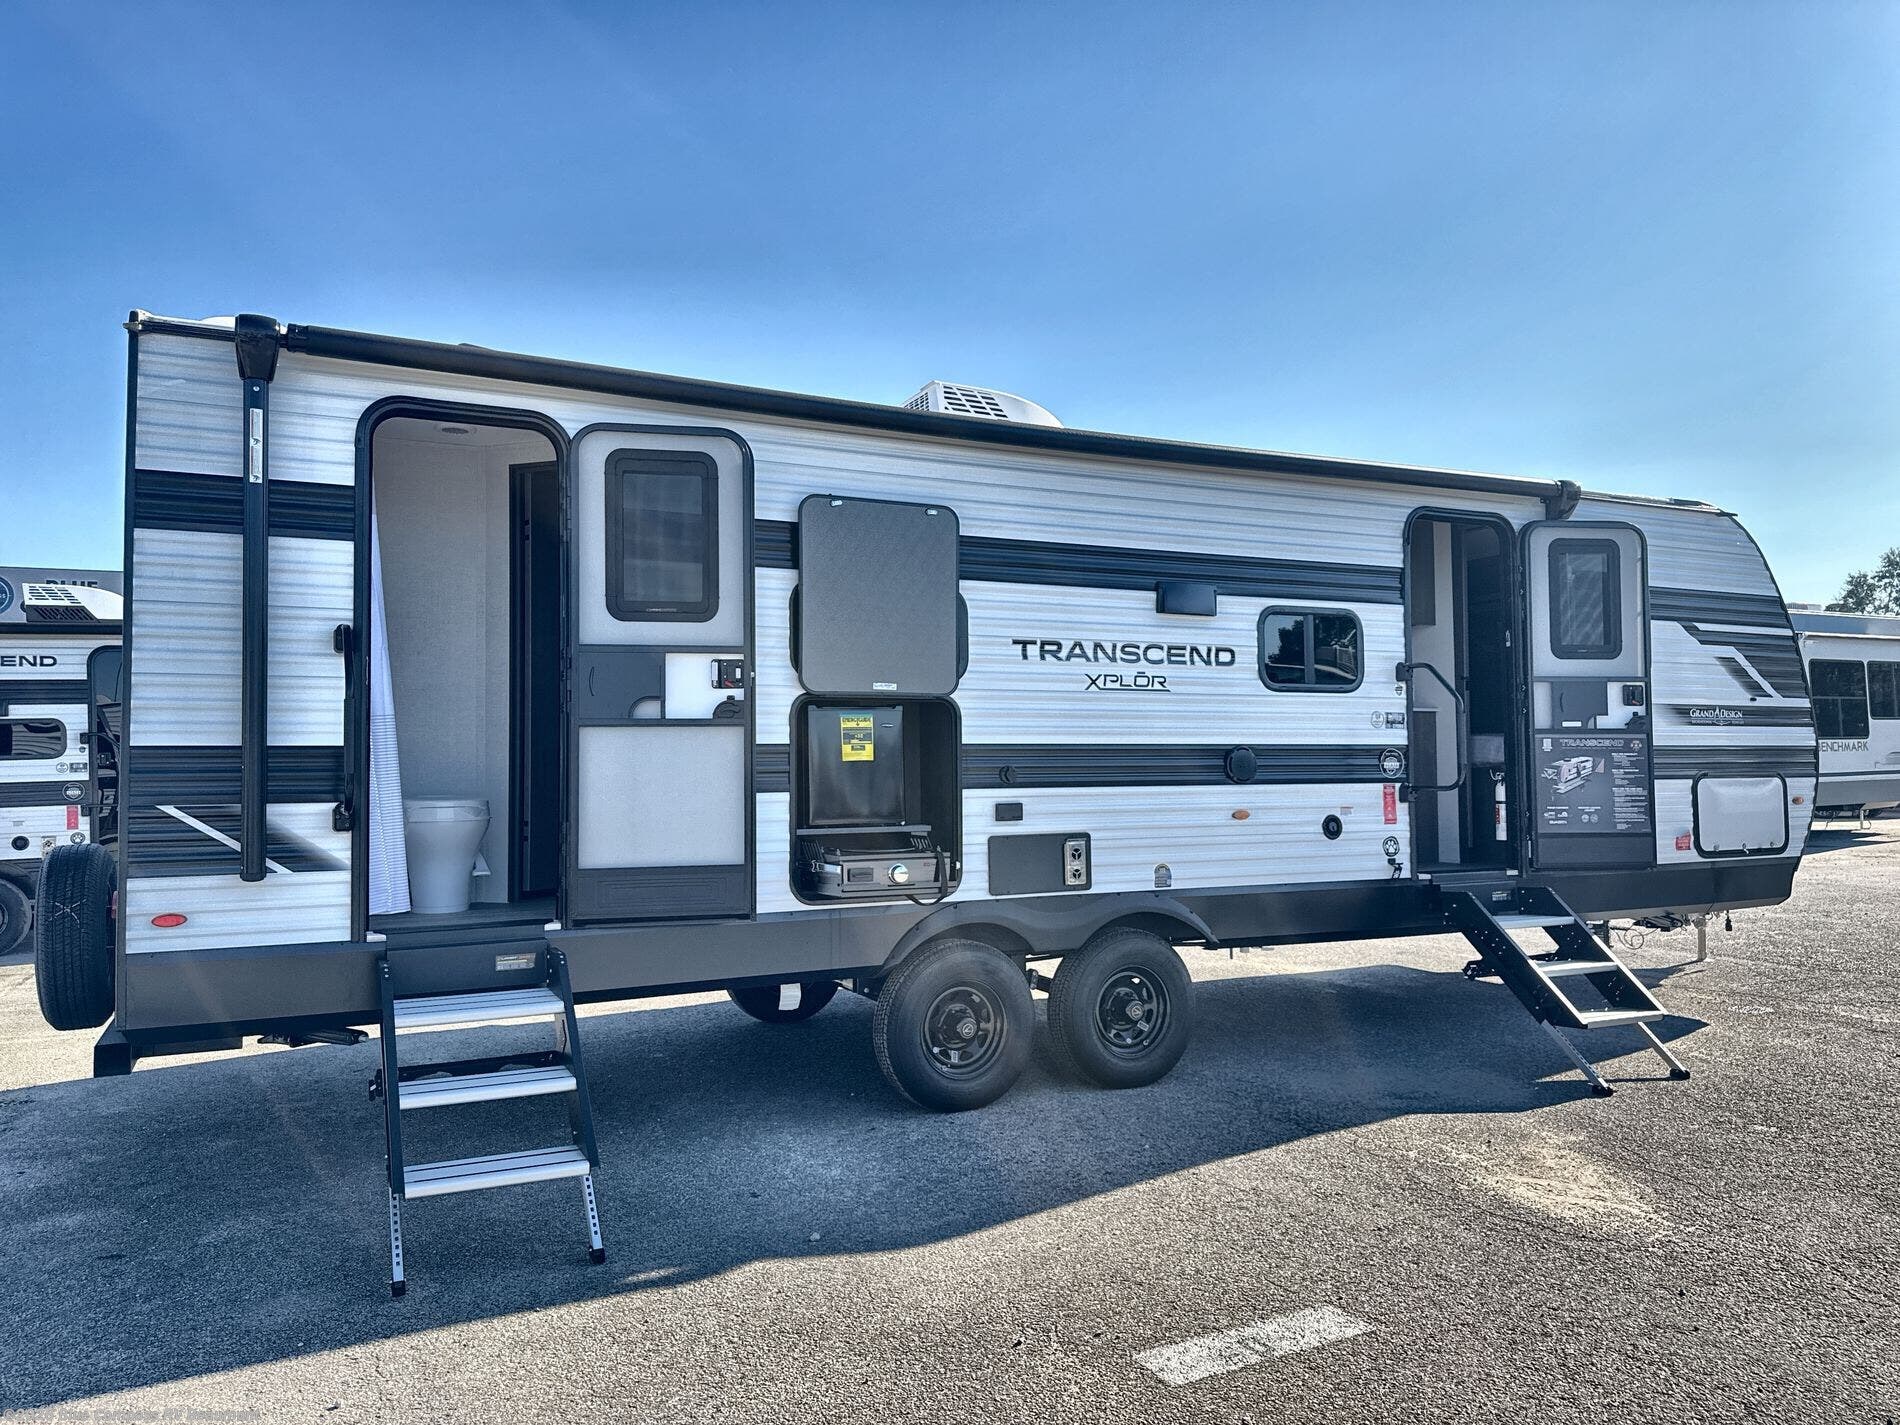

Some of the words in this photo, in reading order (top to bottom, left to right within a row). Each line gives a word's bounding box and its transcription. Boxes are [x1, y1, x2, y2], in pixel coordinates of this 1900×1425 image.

[1012, 638, 1237, 667] TRANSCEND
[0, 655, 58, 667] END
[1690, 708, 1714, 718] GRAND
[1720, 709, 1743, 718] DESIGN
[1559, 738, 1625, 748] TRANSCEND
